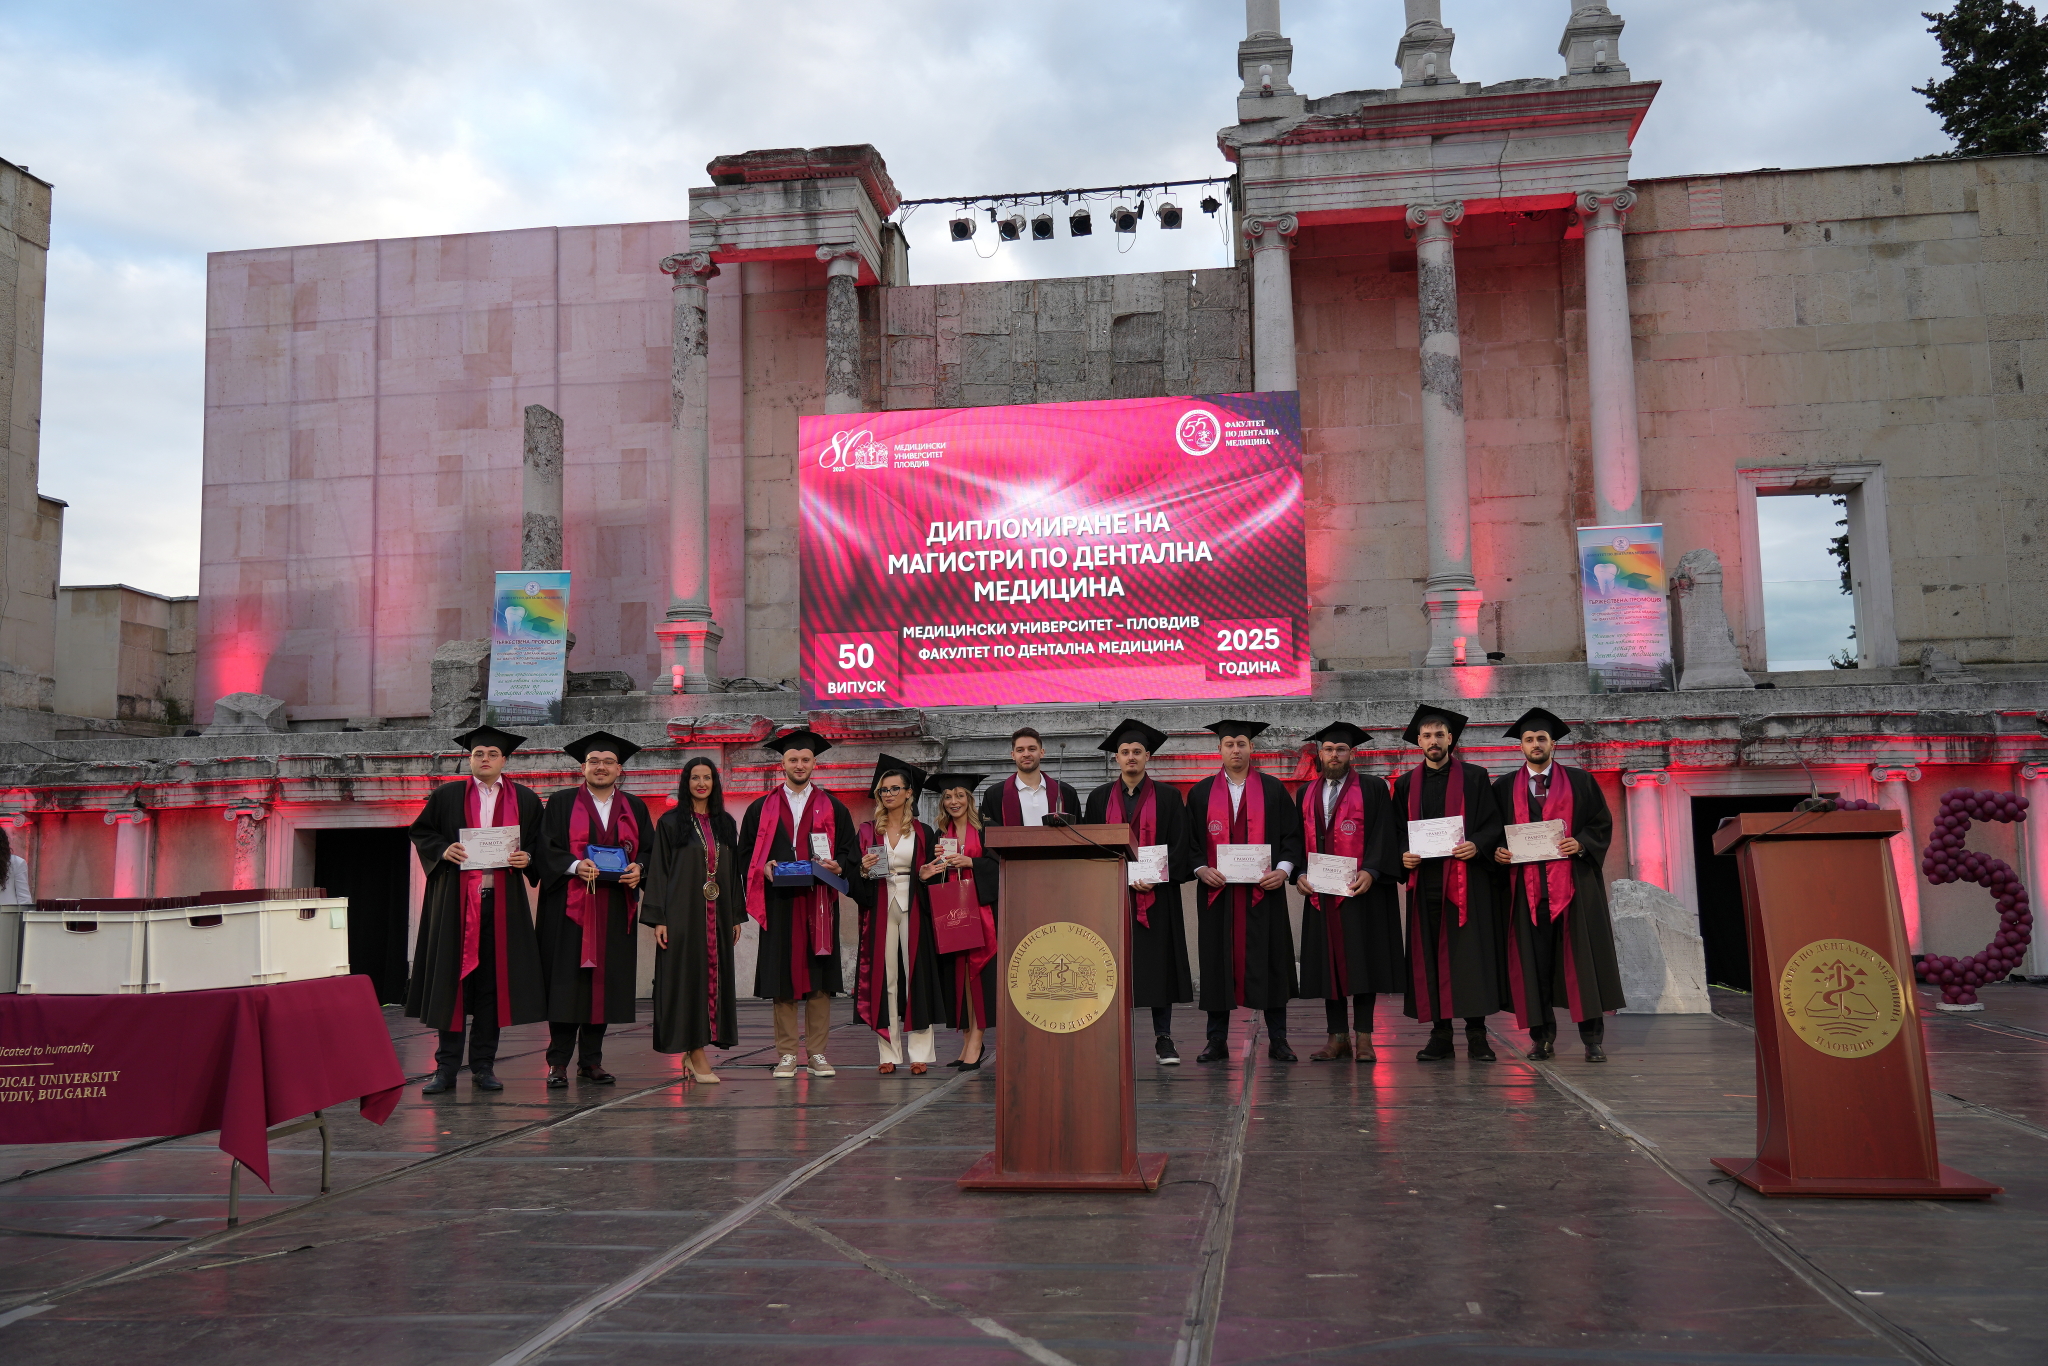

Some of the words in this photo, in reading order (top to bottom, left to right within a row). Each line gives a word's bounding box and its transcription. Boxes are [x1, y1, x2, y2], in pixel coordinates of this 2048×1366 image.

[1238, 428, 1280, 437] ДЕНТАЛНА
[894, 442, 946, 452] МЕДИЦИНСКИ
[1226, 438, 1271, 446] МЕДИЦИНА
[894, 451, 943, 460] УНИВЕРСИТЕТ
[894, 460, 930, 469] ПЛОВДИВ
[926, 514, 1128, 546] ДИПЛОМИРАНЕ
[1134, 512, 1170, 533] НА
[888, 549, 1023, 574] МАГИСТРИ
[1031, 547, 1068, 568] ПО
[1073, 541, 1213, 571] ДЕНТАЛНА
[974, 576, 1125, 604] МЕДИЦИНА
[903, 623, 1006, 639] МЕДИЦИНСКИ
[1010, 619, 1113, 634] УНИВЕРСИТЕТ
[1127, 616, 1200, 630] ПЛОВДИВ
[1217, 628, 1280, 651] 2025
[838, 643, 874, 669] 50
[918, 646, 990, 660] ФАКУЛТЕТ
[994, 646, 1015, 658] ПО
[1018, 642, 1095, 658] ДЕНТАЛНА
[1099, 639, 1184, 654] МЕДИЦИНА
[1218, 661, 1280, 676] ГОДИНА
[828, 680, 886, 694] ВИПУСК
[1011, 925, 1057, 989] МЕДИЦИНСКИ
[1068, 925, 1114, 989] УНИВЕРСИТЕТ
[1784, 960, 1801, 1017] ФАКУЛТЕТ
[1800, 949, 1814, 962] ПО
[1816, 942, 1875, 962] ДЕНТАЛНА
[1876, 961, 1901, 1022] МЕДИЦИНА
[1031, 1013, 1093, 1031] ПЛОВДИВ
[33, 1046, 43, 1056] to
[45, 1043, 94, 1055] humanity
[1815, 1036, 1874, 1052] ПЛОВДИВ
[39, 1071, 120, 1085] UNIVERSITY
[38, 1086, 107, 1101] BULGARIA
